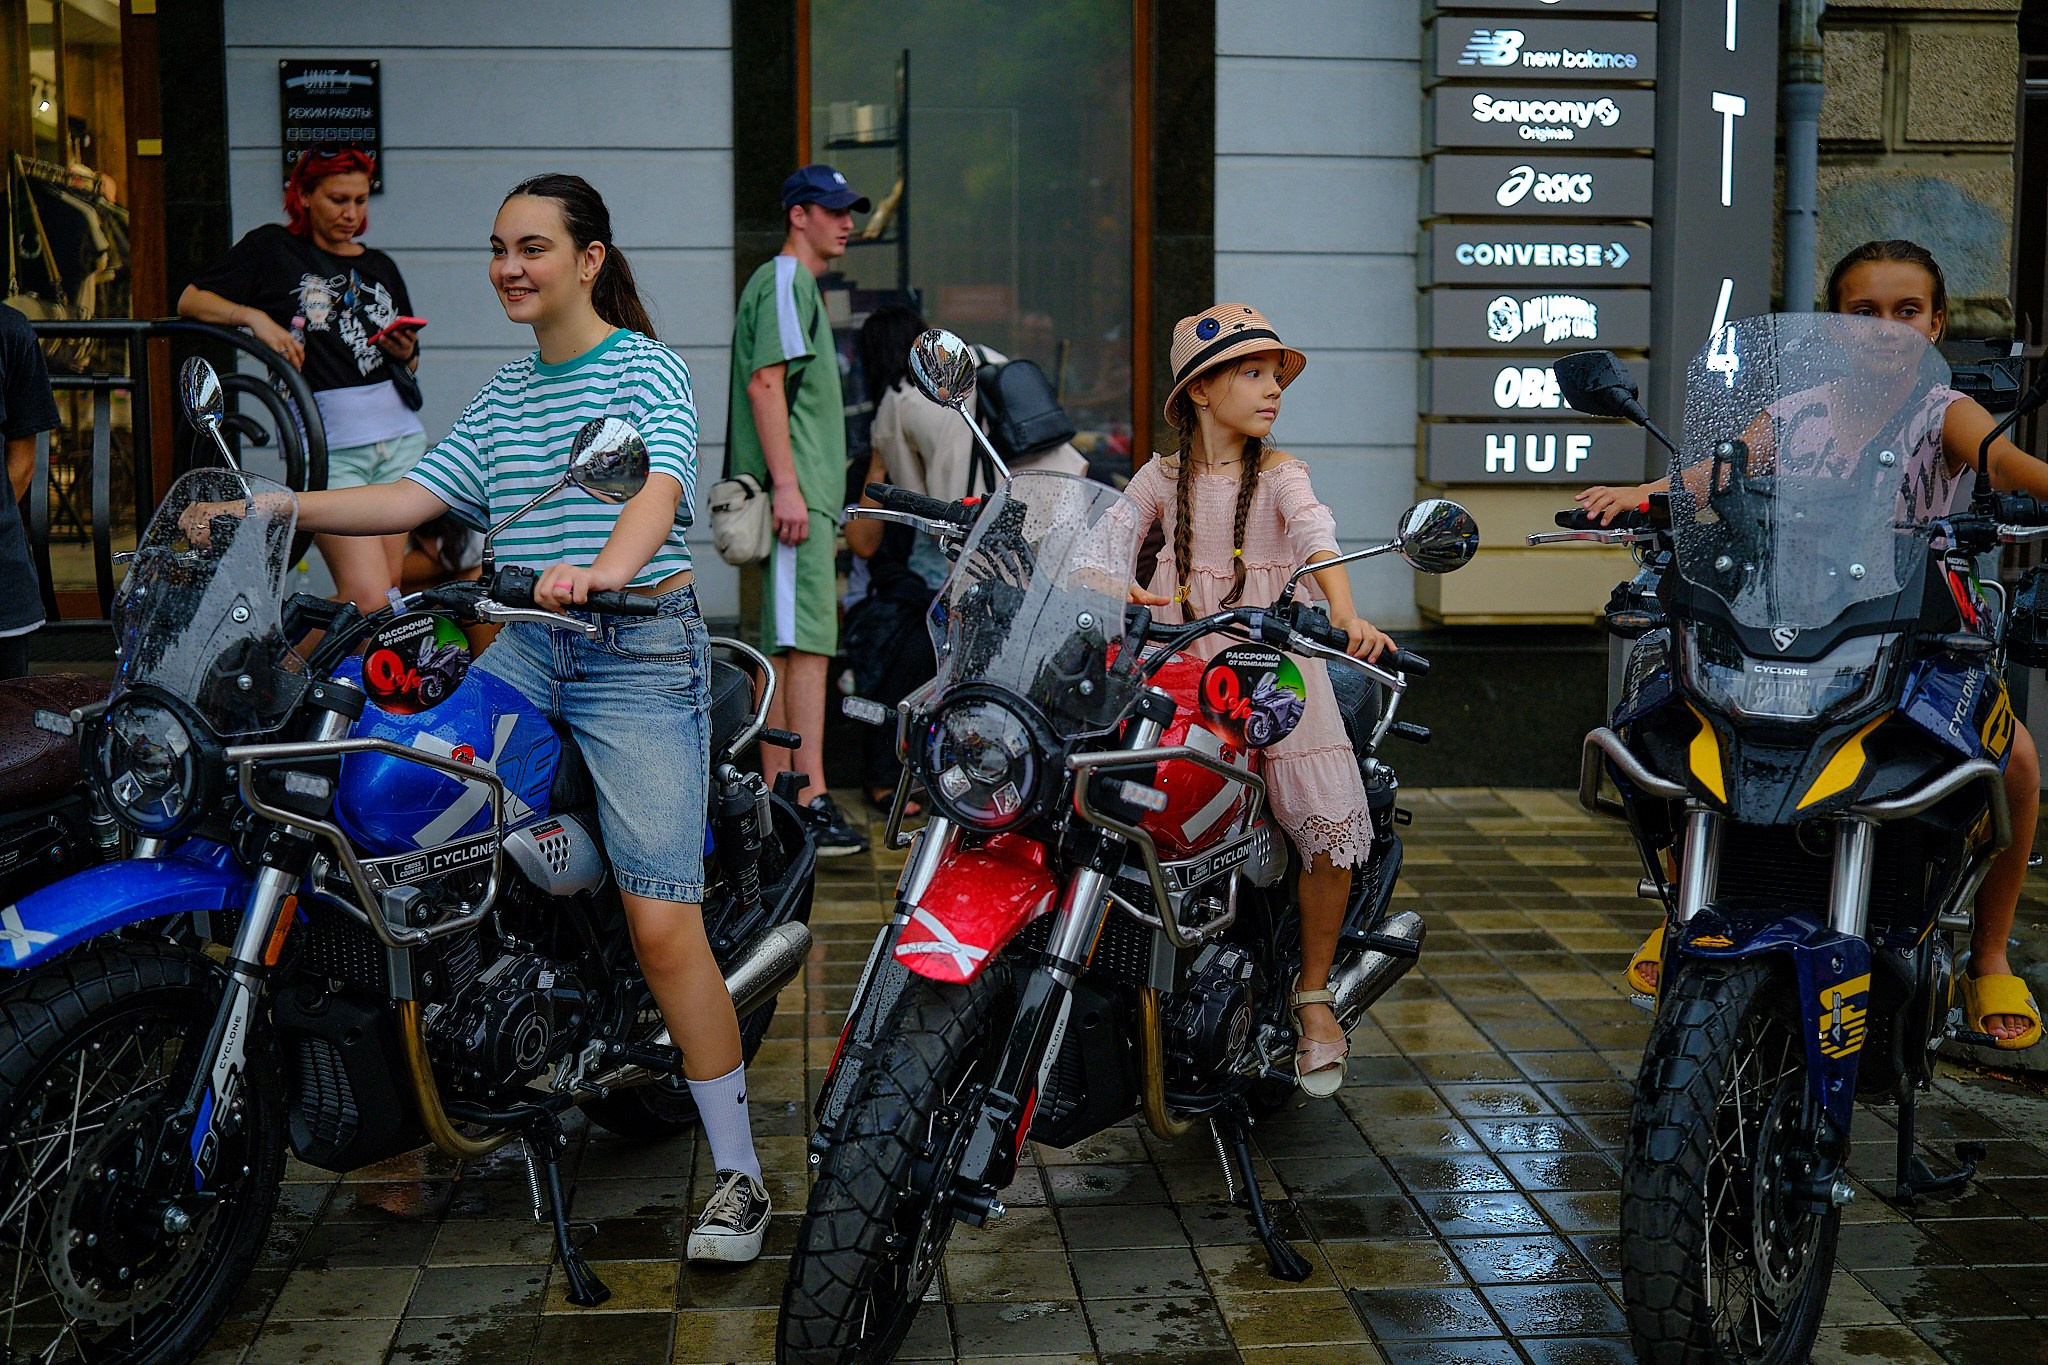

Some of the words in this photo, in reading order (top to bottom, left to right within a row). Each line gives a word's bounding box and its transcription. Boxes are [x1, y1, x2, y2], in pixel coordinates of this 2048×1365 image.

[1522, 51, 1561, 68] new
[1562, 48, 1638, 69] balance
[288, 107, 327, 119] РЕЖИМ
[1472, 94, 1595, 128] Saucony
[1518, 125, 1574, 142] Originals
[1455, 243, 1603, 267] CONVERSE
[1494, 366, 1573, 409] OBE
[1485, 434, 1593, 474] HUF
[378, 616, 434, 641] РАССРОЧКА
[383, 639, 393, 647] ОТ
[1225, 651, 1281, 661] РАССРОЧКА
[365, 649, 421, 695] 0%
[1754, 665, 1809, 676] CYCLONE
[1204, 666, 1253, 719] 0%
[1948, 665, 1979, 737] CYCLONE
[404, 861, 422, 871] CROSS
[433, 841, 495, 869] CYCLONE
[400, 866, 424, 878] COUNTRY
[1831, 991, 1841, 1042] ABS
[219, 1015, 242, 1070] CYCLONE
[1043, 1018, 1065, 1071] CYCLONE
